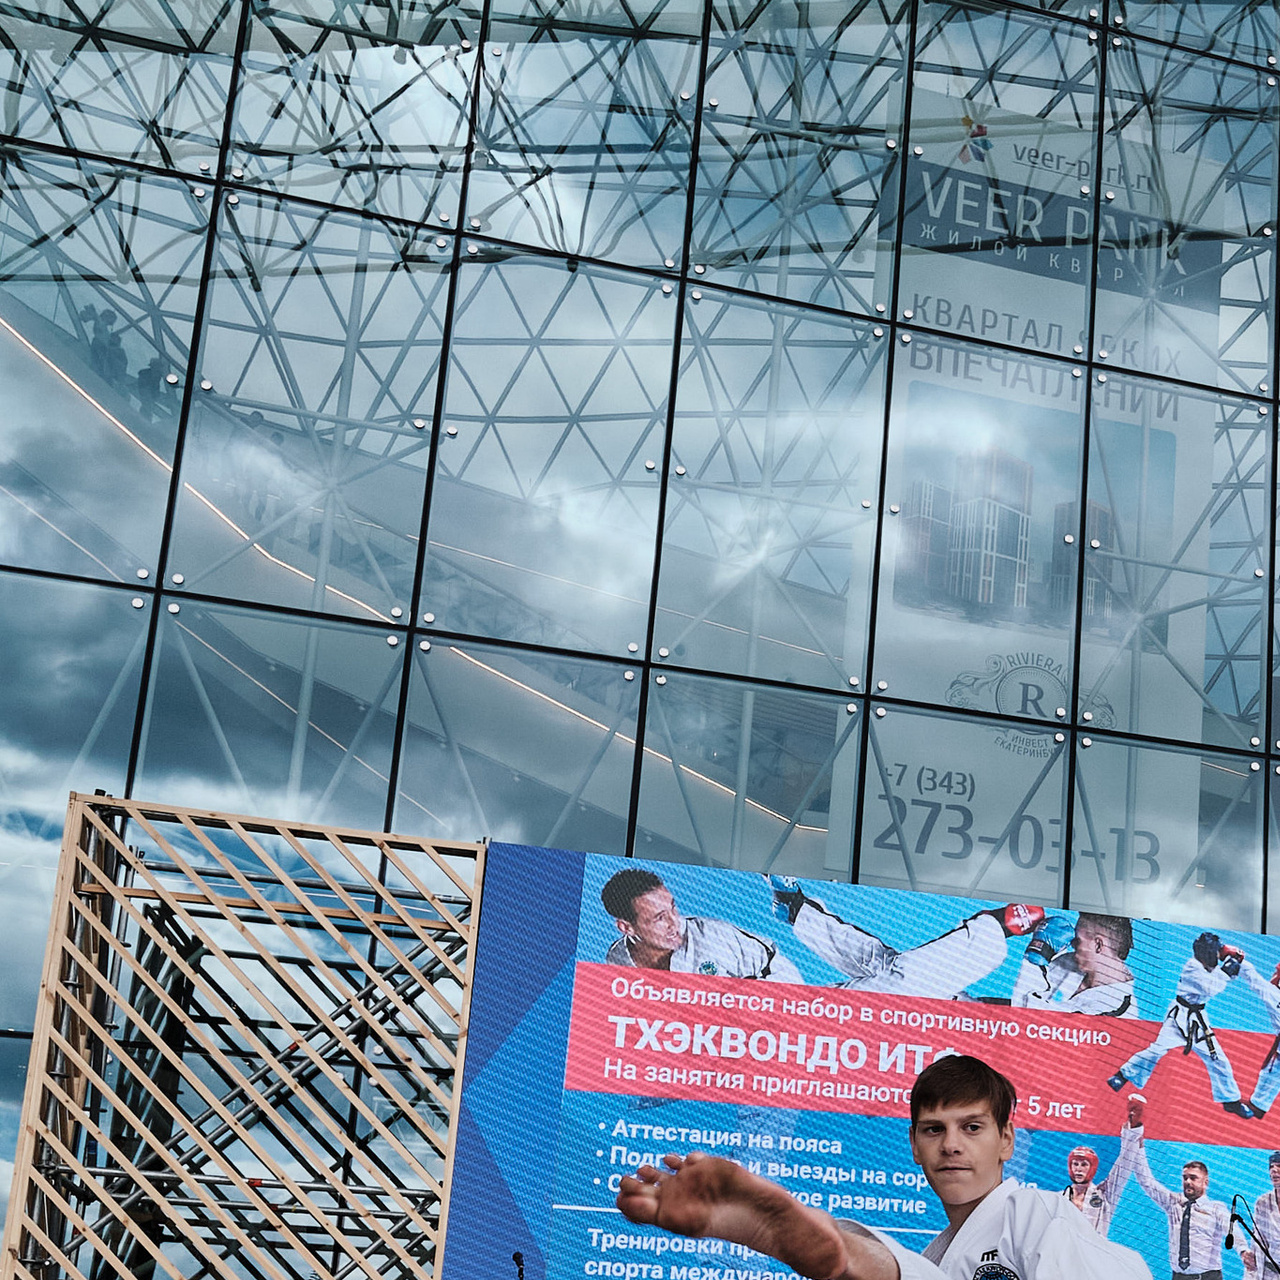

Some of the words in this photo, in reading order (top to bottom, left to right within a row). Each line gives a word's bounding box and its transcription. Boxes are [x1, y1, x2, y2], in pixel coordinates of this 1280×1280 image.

[922, 171, 1043, 243] VEER
[920, 223, 1028, 261] ЖИЛОЙ
[912, 293, 1064, 352] КВАРТАЛ
[1006, 652, 1063, 676] RIVIERA
[1018, 681, 1048, 718] R
[1010, 734, 1049, 748] ИНВЕСТ
[916, 765, 976, 802] (343)
[611, 977, 775, 1013] Объявляется
[782, 996, 853, 1024] набор
[860, 1007, 873, 1022] в
[880, 1008, 1020, 1039] спортивную
[1025, 1022, 1111, 1047] секцию
[607, 1015, 868, 1074] ТХЭКВОНДО
[878, 1041, 963, 1075] ИТ
[603, 1057, 637, 1081] На
[644, 1064, 745, 1090] занятия
[1028, 1095, 1041, 1115] 5
[1045, 1098, 1086, 1119] лет
[611, 1119, 743, 1148] Аттестация
[748, 1134, 774, 1149] на
[779, 1135, 842, 1154] пояса
[748, 1161, 761, 1174] и
[767, 1162, 856, 1185] выезды
[862, 1169, 887, 1185] на
[828, 1193, 927, 1214] развитие
[587, 1228, 723, 1255] Тренировки
[584, 1260, 664, 1280] спорта
